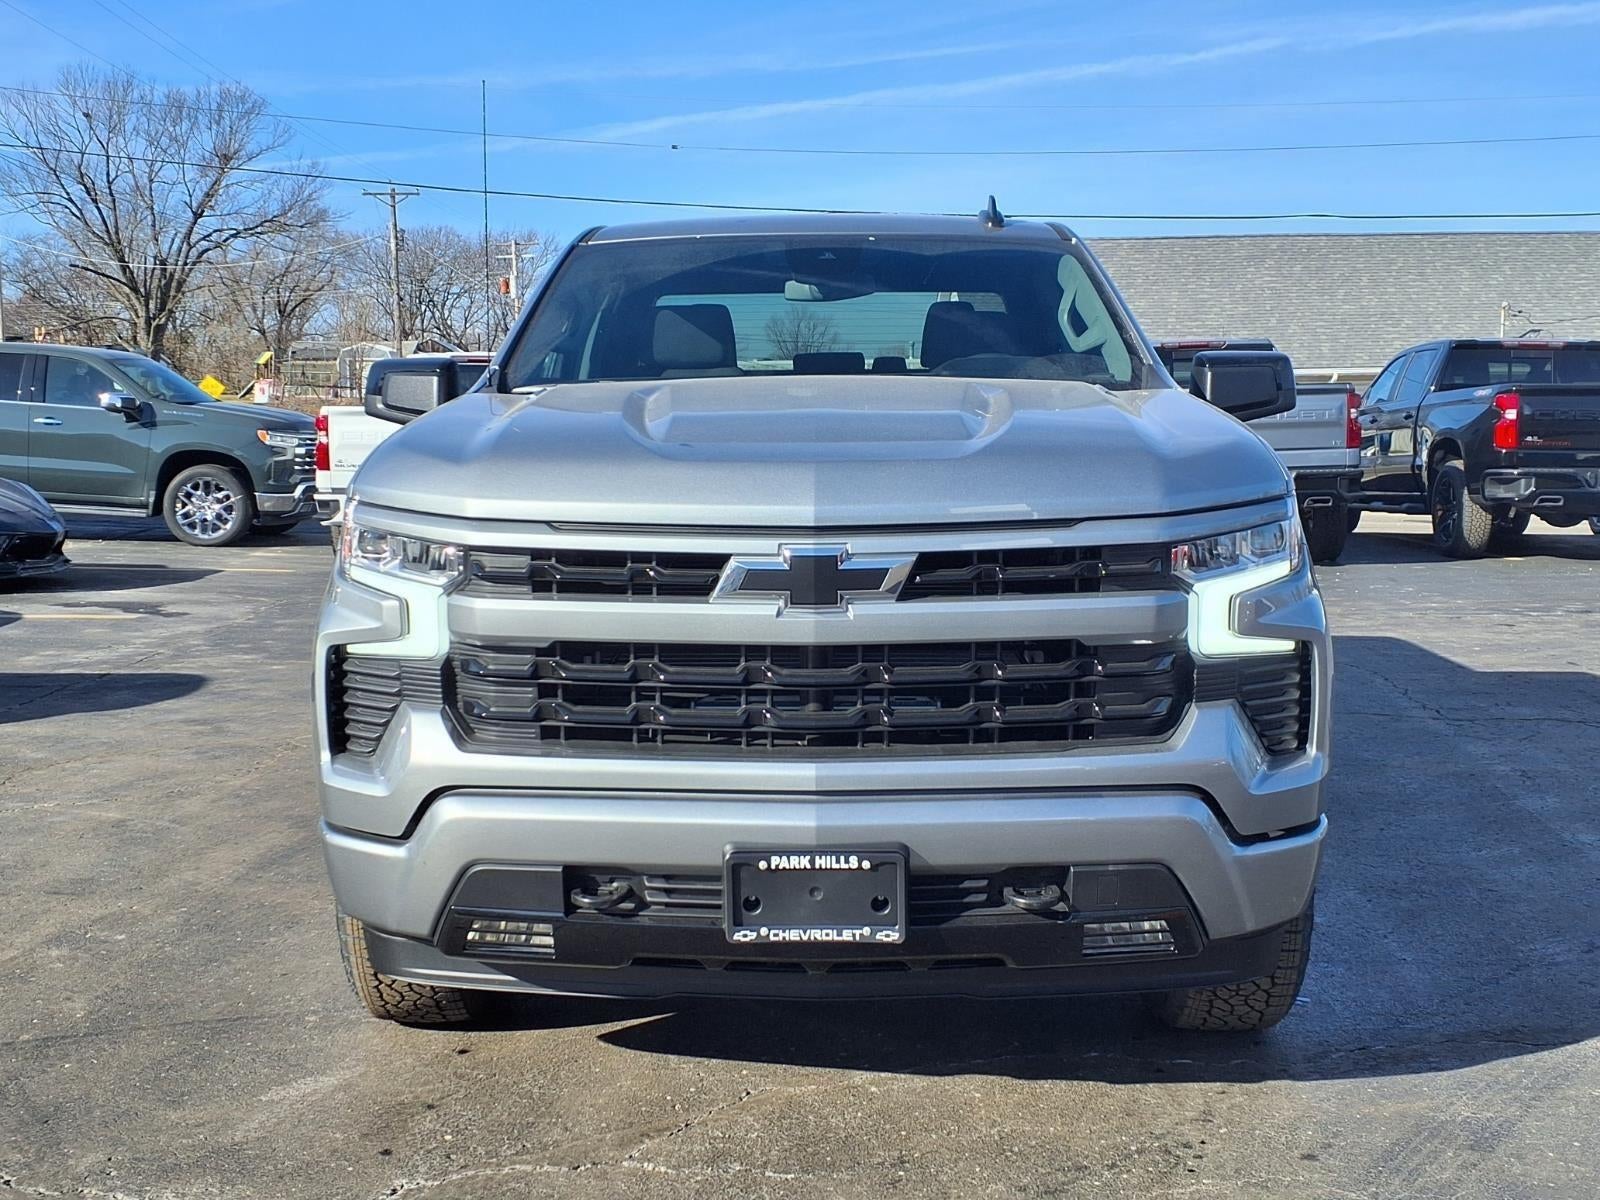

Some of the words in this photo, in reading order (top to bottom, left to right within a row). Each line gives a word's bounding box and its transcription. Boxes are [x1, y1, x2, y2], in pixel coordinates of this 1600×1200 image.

[770, 855, 809, 869] PARK
[814, 855, 859, 869] HILLS
[769, 929, 862, 941] CHEVROLET
